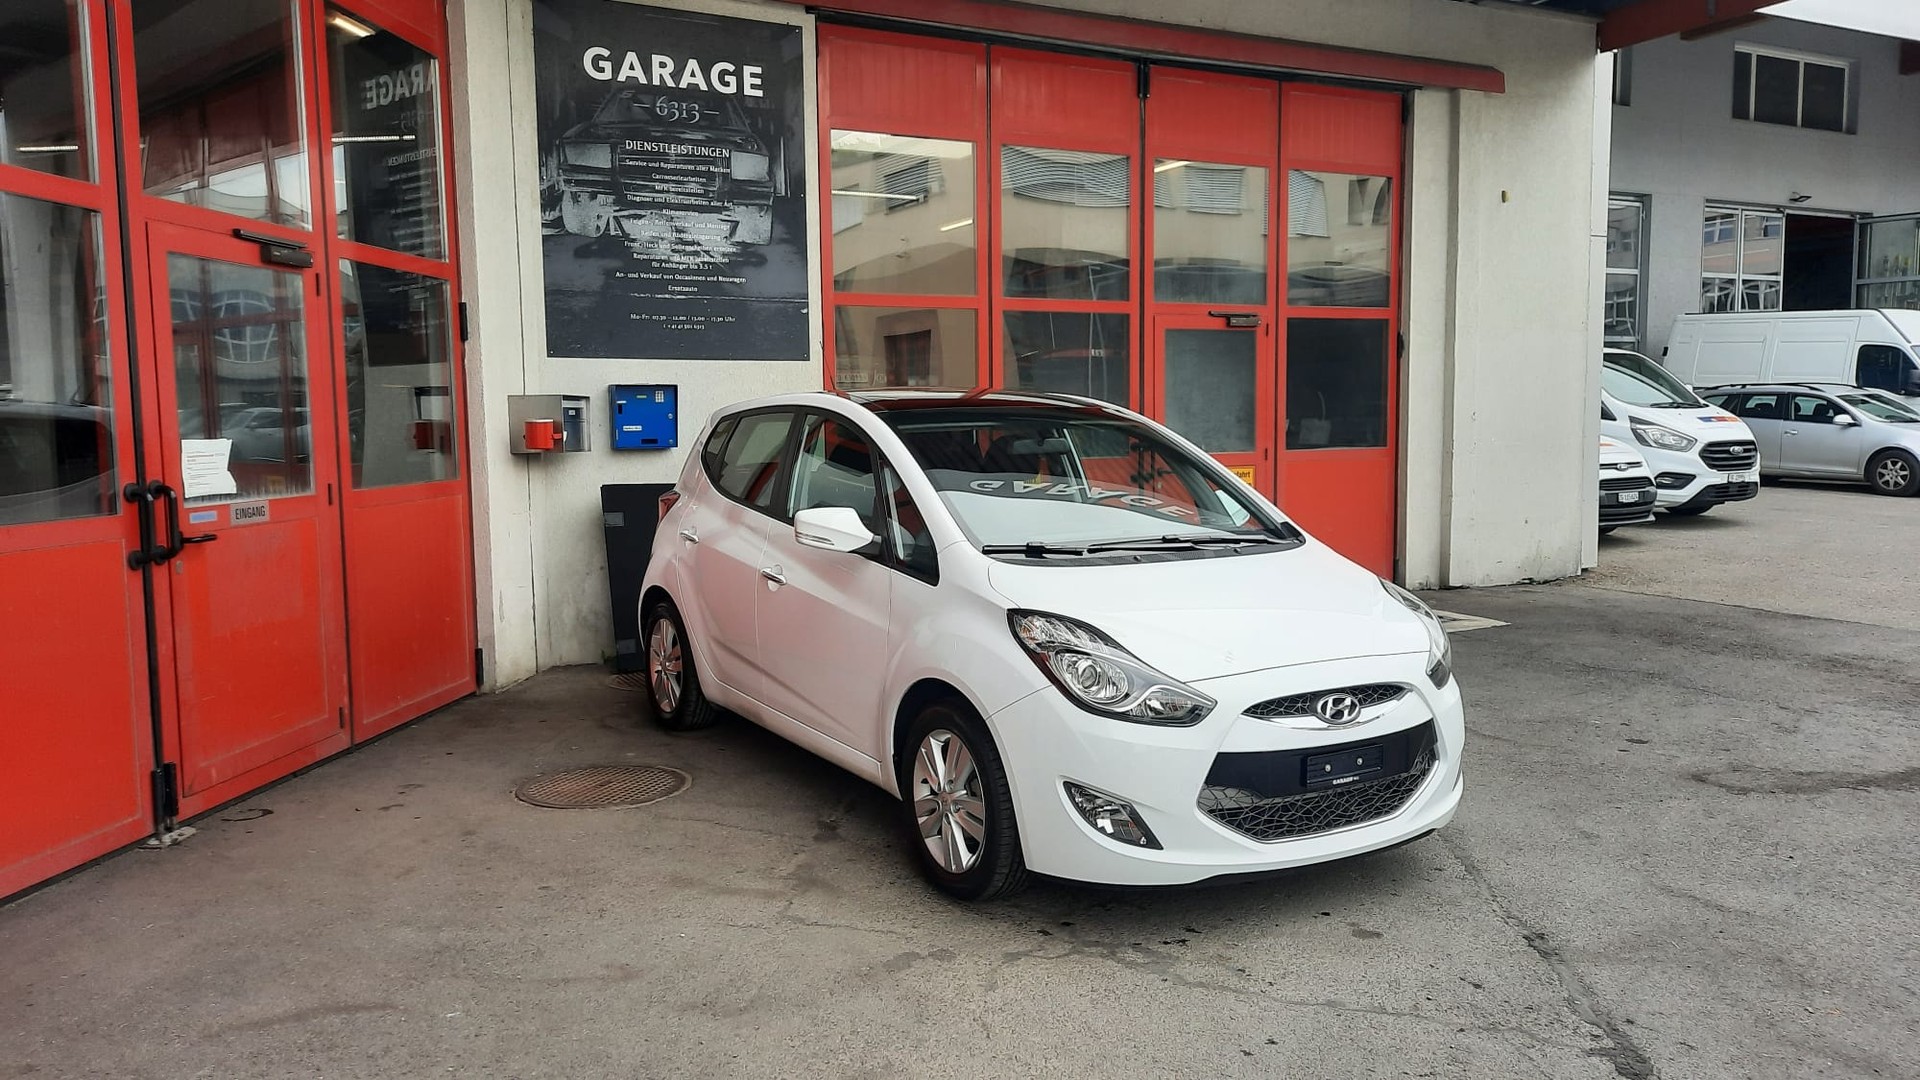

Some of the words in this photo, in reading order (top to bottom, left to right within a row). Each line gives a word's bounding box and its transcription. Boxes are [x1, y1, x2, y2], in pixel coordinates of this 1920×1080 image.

[583, 46, 764, 97] GARAGE
[655, 95, 700, 124] 6313
[625, 140, 730, 158] DIENSTLEISTUNGEN
[625, 159, 647, 167] Service
[648, 160, 660, 168] und
[660, 162, 695, 171] Reparaturen
[696, 164, 709, 172] aller
[651, 173, 707, 183] Carrosseriearbeiten
[661, 262, 689, 270] Anhänger
[718, 276, 747, 284] Neuwagen
[668, 284, 698, 292] Ersatzauto
[235, 505, 266, 520] EINGANG
